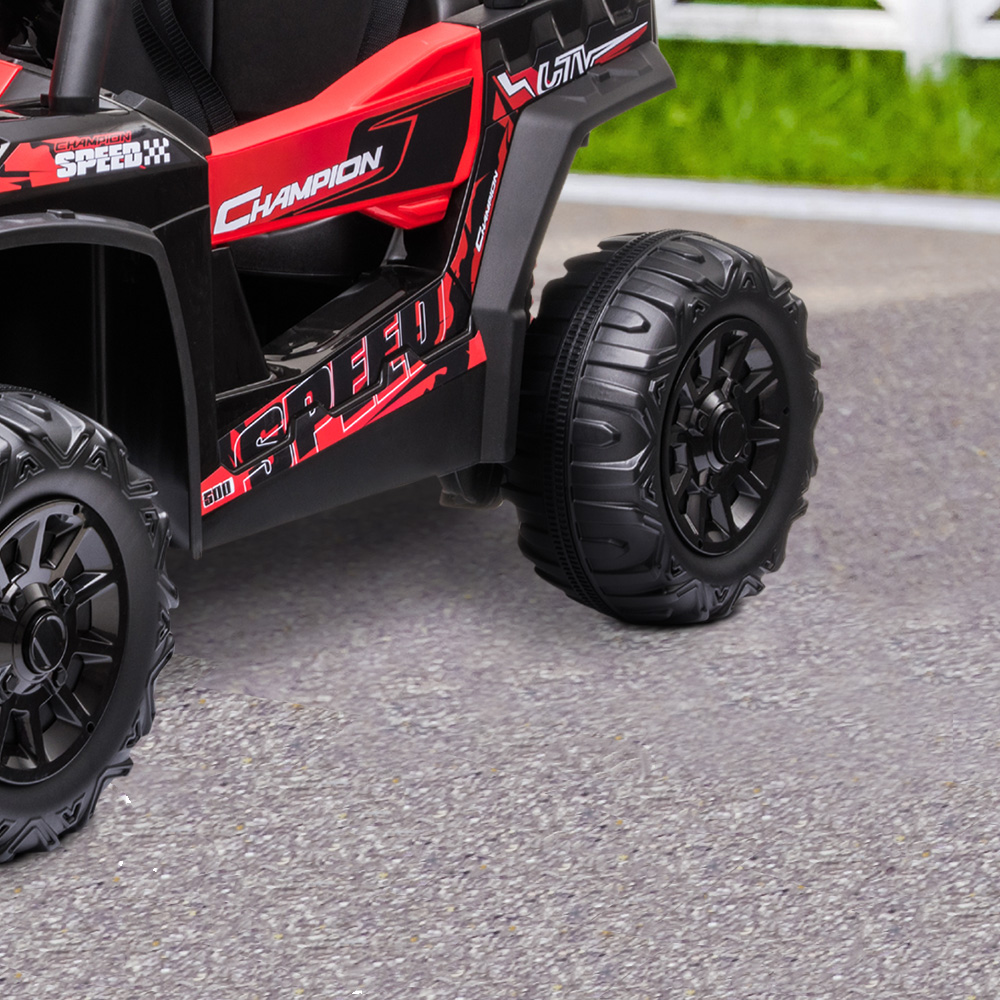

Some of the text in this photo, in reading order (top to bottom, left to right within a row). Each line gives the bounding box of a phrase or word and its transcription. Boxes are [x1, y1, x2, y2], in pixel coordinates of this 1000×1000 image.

[54, 130, 132, 151] CHAMPION
[54, 141, 143, 178] SPEED
[213, 145, 384, 235] CHAMPION
[475, 169, 499, 253] CHAMPION
[202, 477, 235, 508] 500
